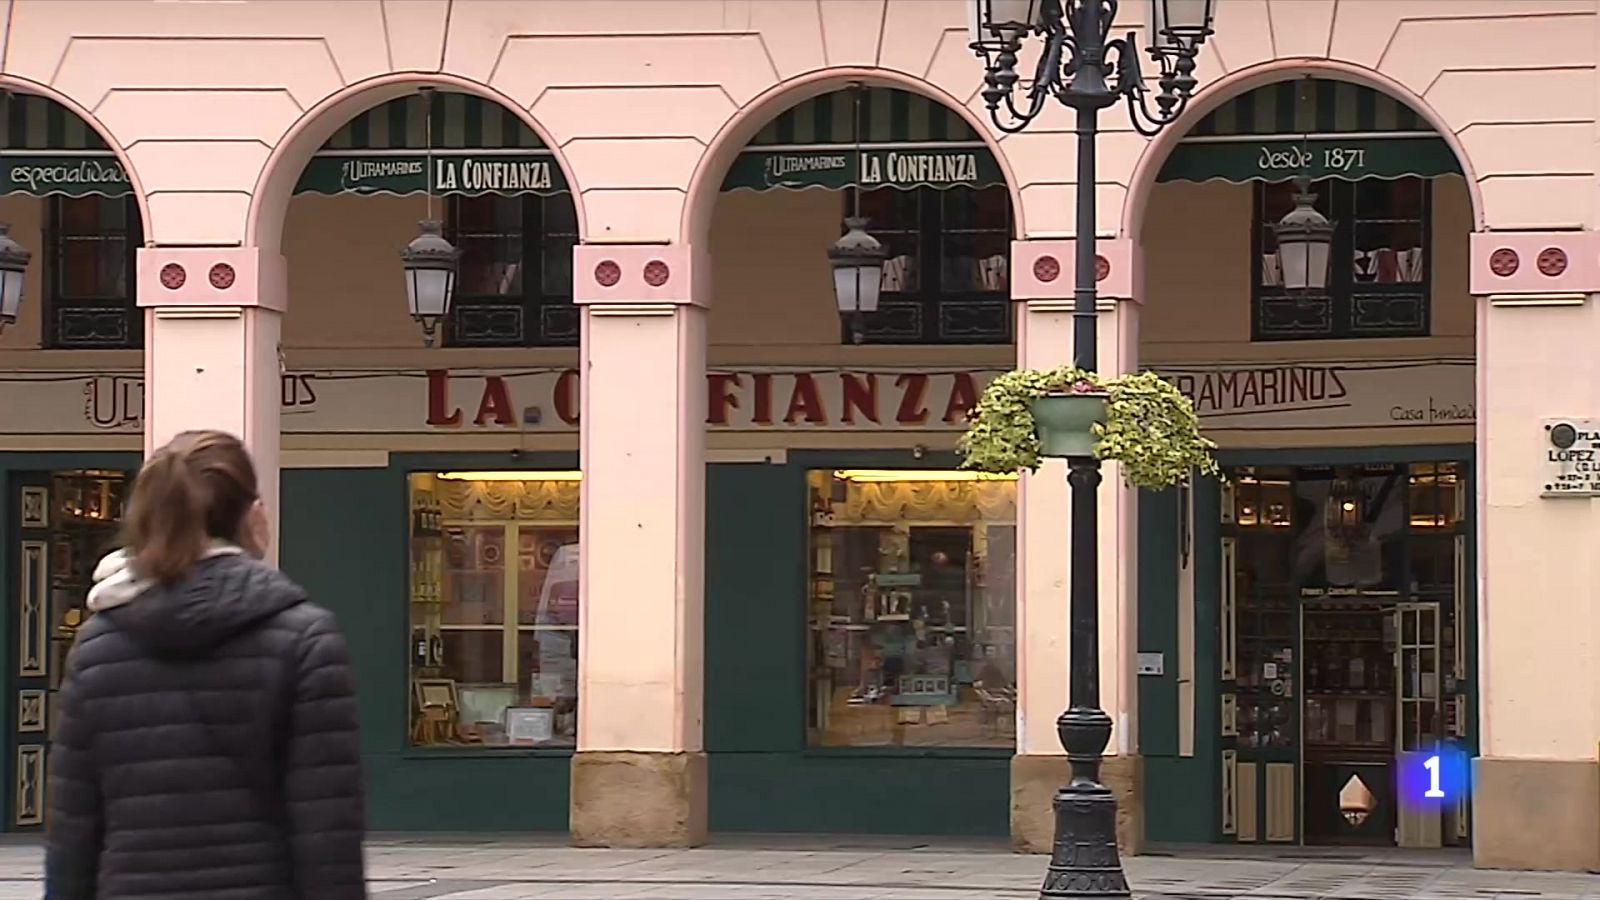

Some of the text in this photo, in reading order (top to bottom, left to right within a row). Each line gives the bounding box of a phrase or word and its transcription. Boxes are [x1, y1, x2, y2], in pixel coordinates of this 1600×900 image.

[436, 159, 456, 189] LA
[462, 158, 551, 189] CONFIANZA
[860, 153, 881, 183] LA
[887, 152, 978, 183] CONFIANZA
[1259, 146, 1365, 171] desde 1871
[426, 369, 516, 427] LA
[1390, 406, 1424, 420] Casa
